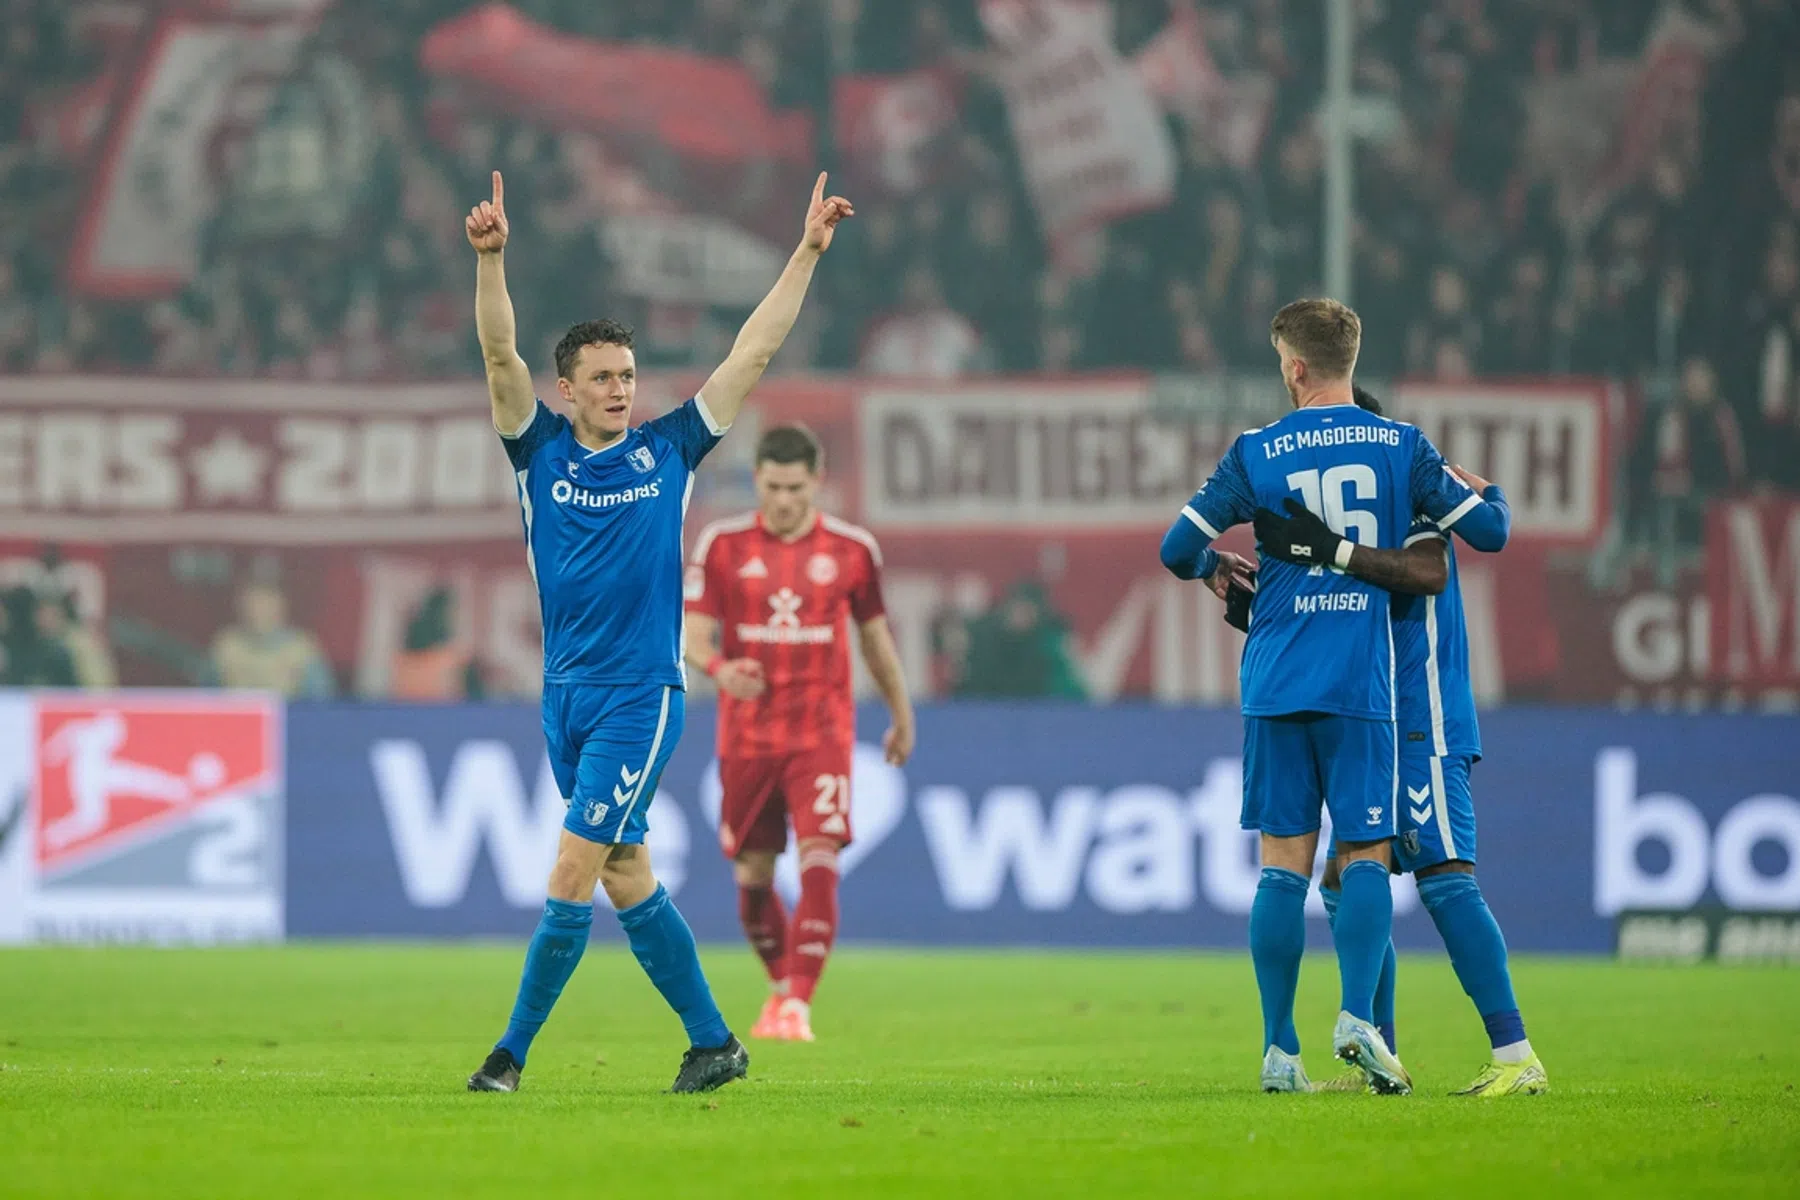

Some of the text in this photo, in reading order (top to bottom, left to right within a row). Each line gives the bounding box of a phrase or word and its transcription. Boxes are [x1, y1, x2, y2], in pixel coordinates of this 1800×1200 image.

[276, 413, 519, 510] 200
[1263, 426, 1400, 459] 1.FC MAGDEBURG
[1286, 464, 1378, 575] 16
[1294, 592, 1368, 614] MATHISEN
[812, 773, 850, 815] 21
